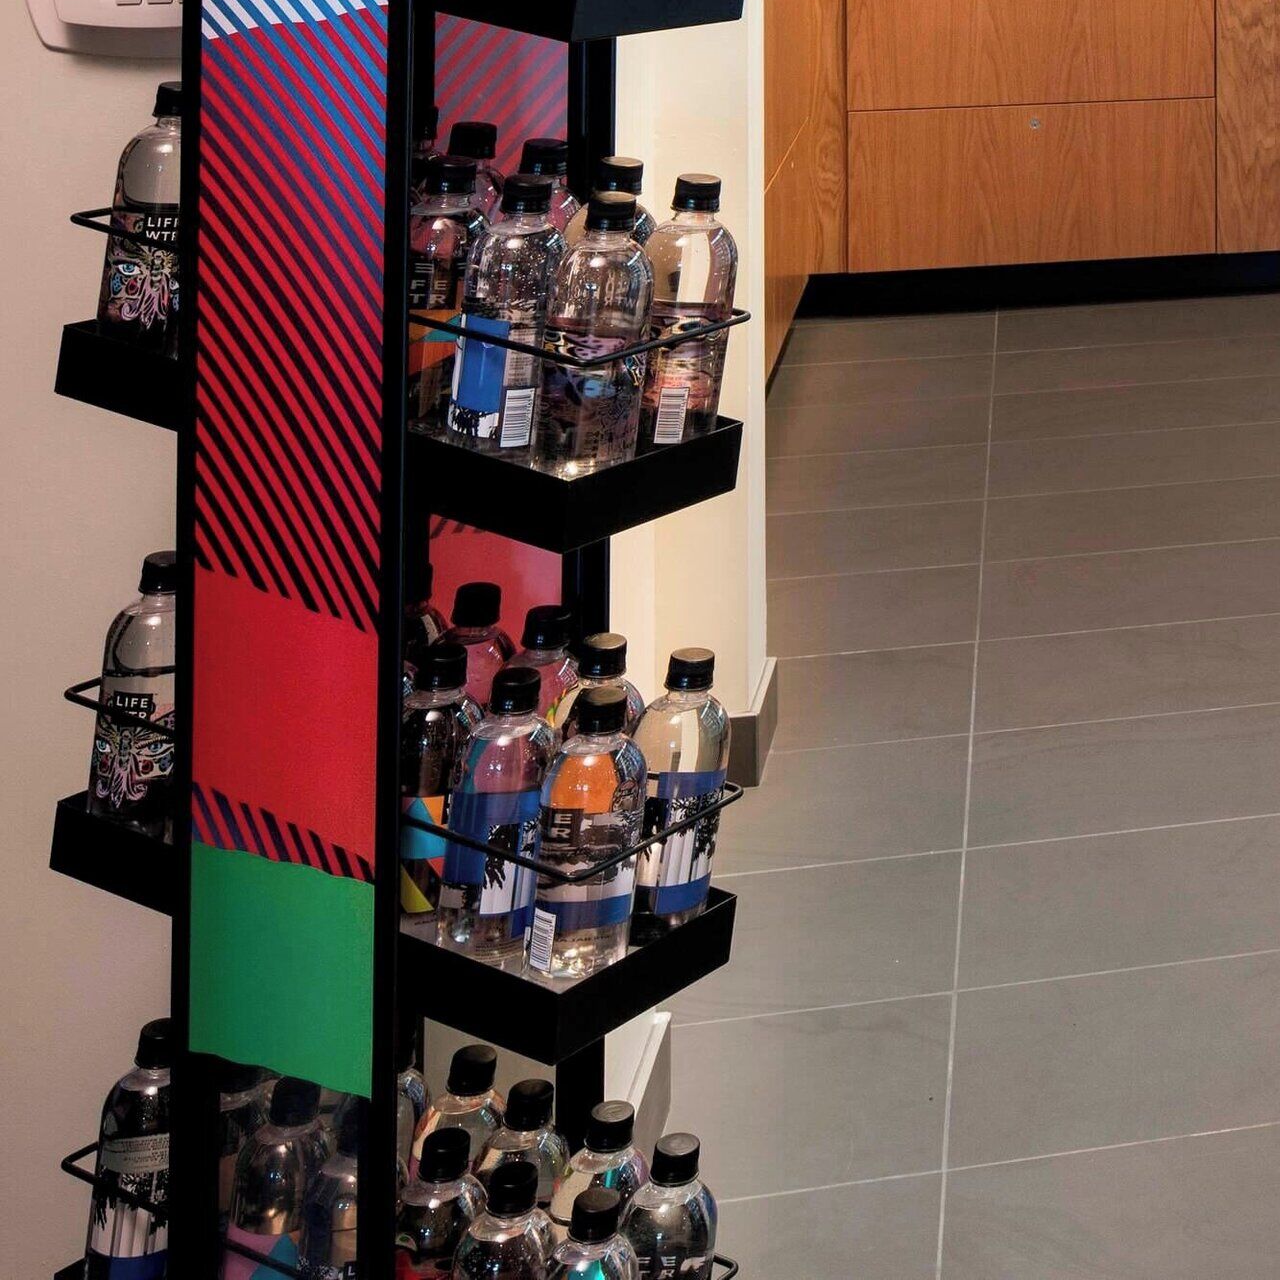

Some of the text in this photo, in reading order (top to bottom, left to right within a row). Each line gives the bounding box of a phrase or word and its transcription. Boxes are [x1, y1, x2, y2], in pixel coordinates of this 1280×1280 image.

[410, 279, 448, 290] FE
[409, 293, 446, 304] TR
[116, 695, 149, 708] LIFE
